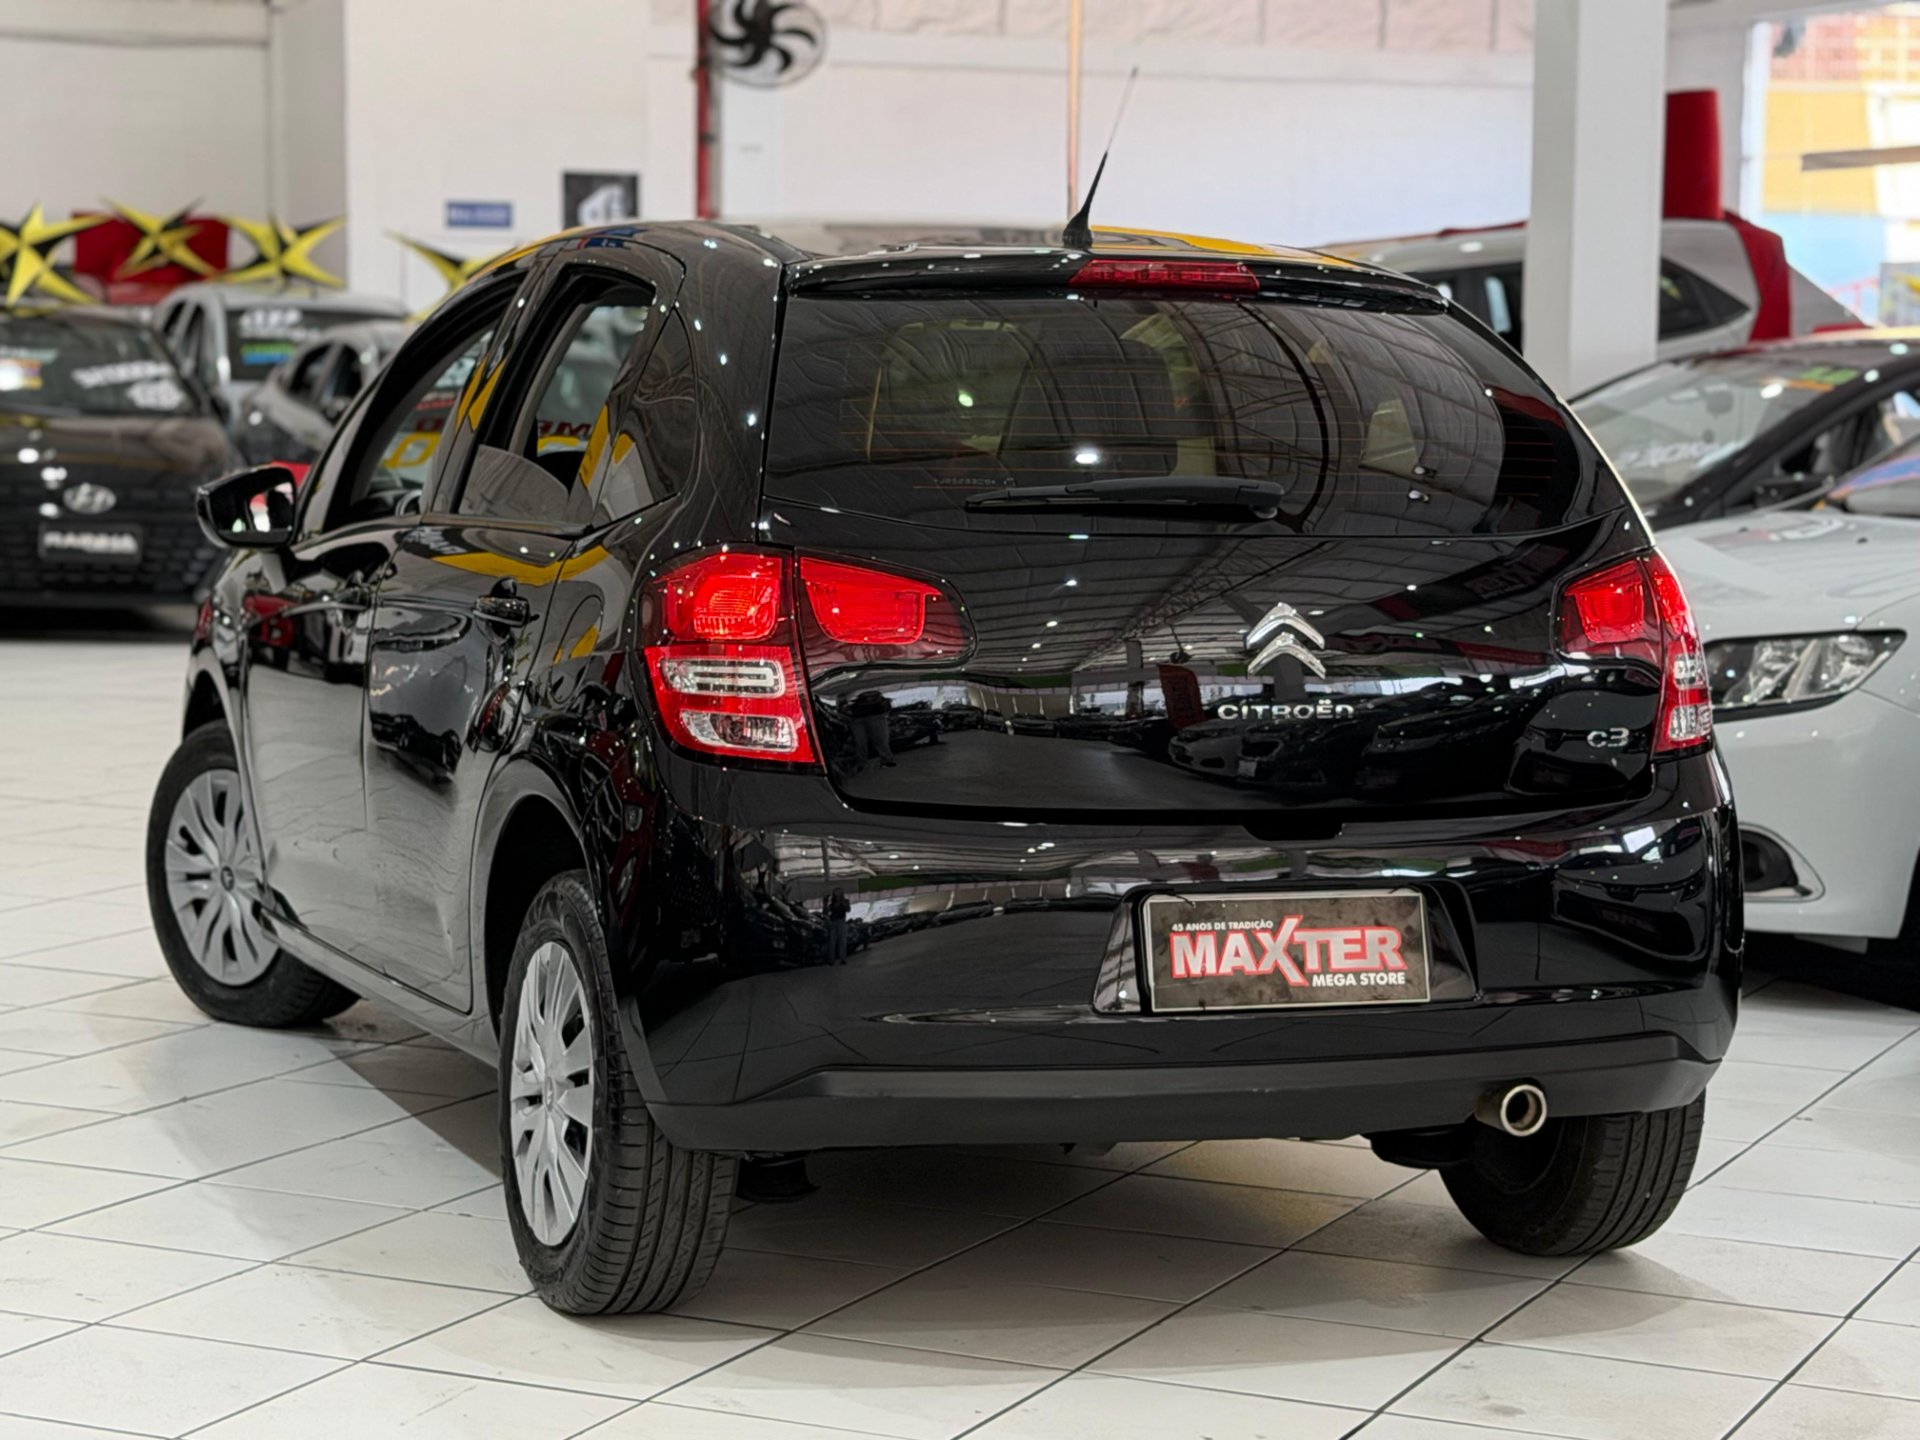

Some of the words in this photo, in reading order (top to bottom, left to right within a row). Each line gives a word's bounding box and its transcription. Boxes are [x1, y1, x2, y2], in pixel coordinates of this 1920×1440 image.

[1587, 727, 1629, 748] C3
[1171, 923, 1184, 932] 45
[1185, 922, 1212, 931] ANOS
[1214, 921, 1226, 930] DE
[1228, 919, 1274, 931] TRADIÇÃO
[1169, 914, 1409, 987] MAXTER
[1312, 973, 1357, 987] MEGA
[1360, 972, 1406, 986] STORE
